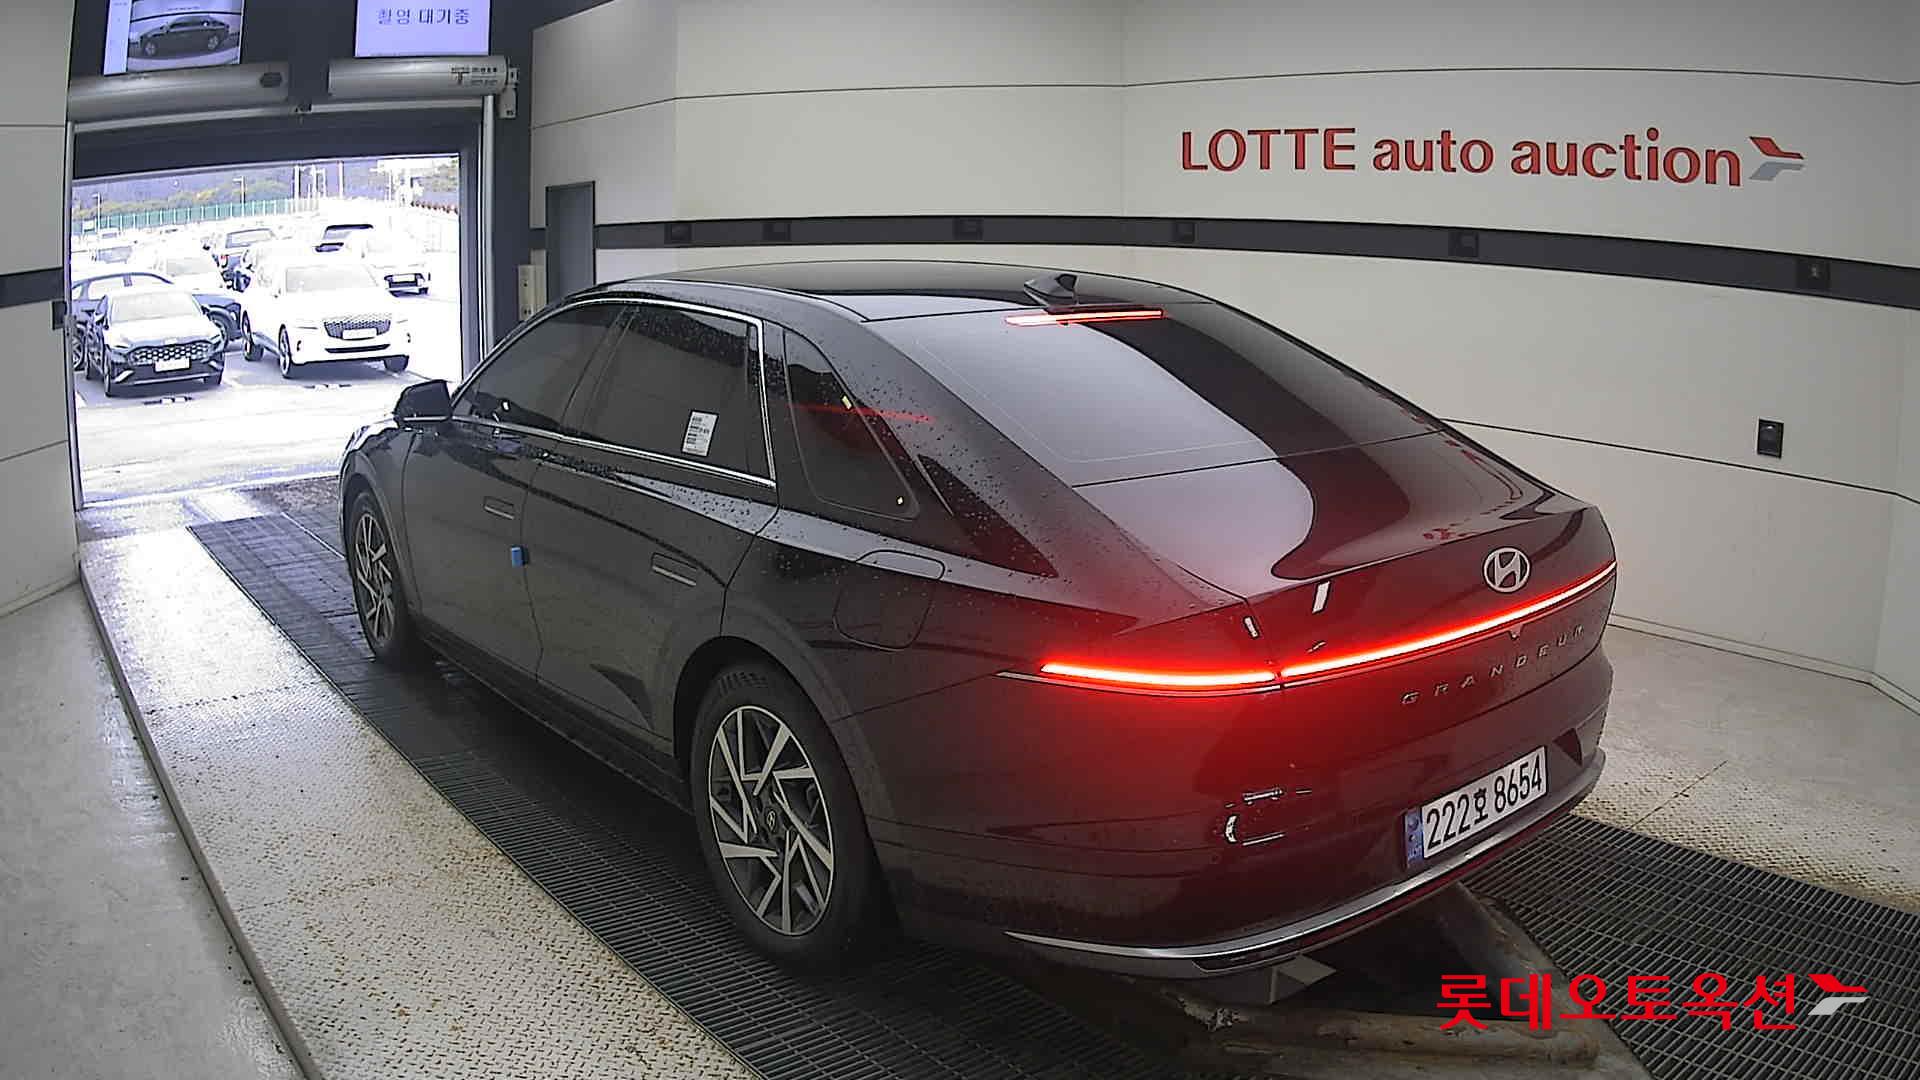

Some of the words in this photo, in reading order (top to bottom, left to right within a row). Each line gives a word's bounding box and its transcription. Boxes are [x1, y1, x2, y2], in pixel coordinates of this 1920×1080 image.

[419, 8, 470, 25] 대기중
[1182, 128, 1357, 171] LOTTE
[1372, 130, 1495, 173] auto
[1510, 127, 1742, 187] auction
[1402, 624, 1584, 704] GRANDEUR
[1494, 754, 1542, 813] 8654
